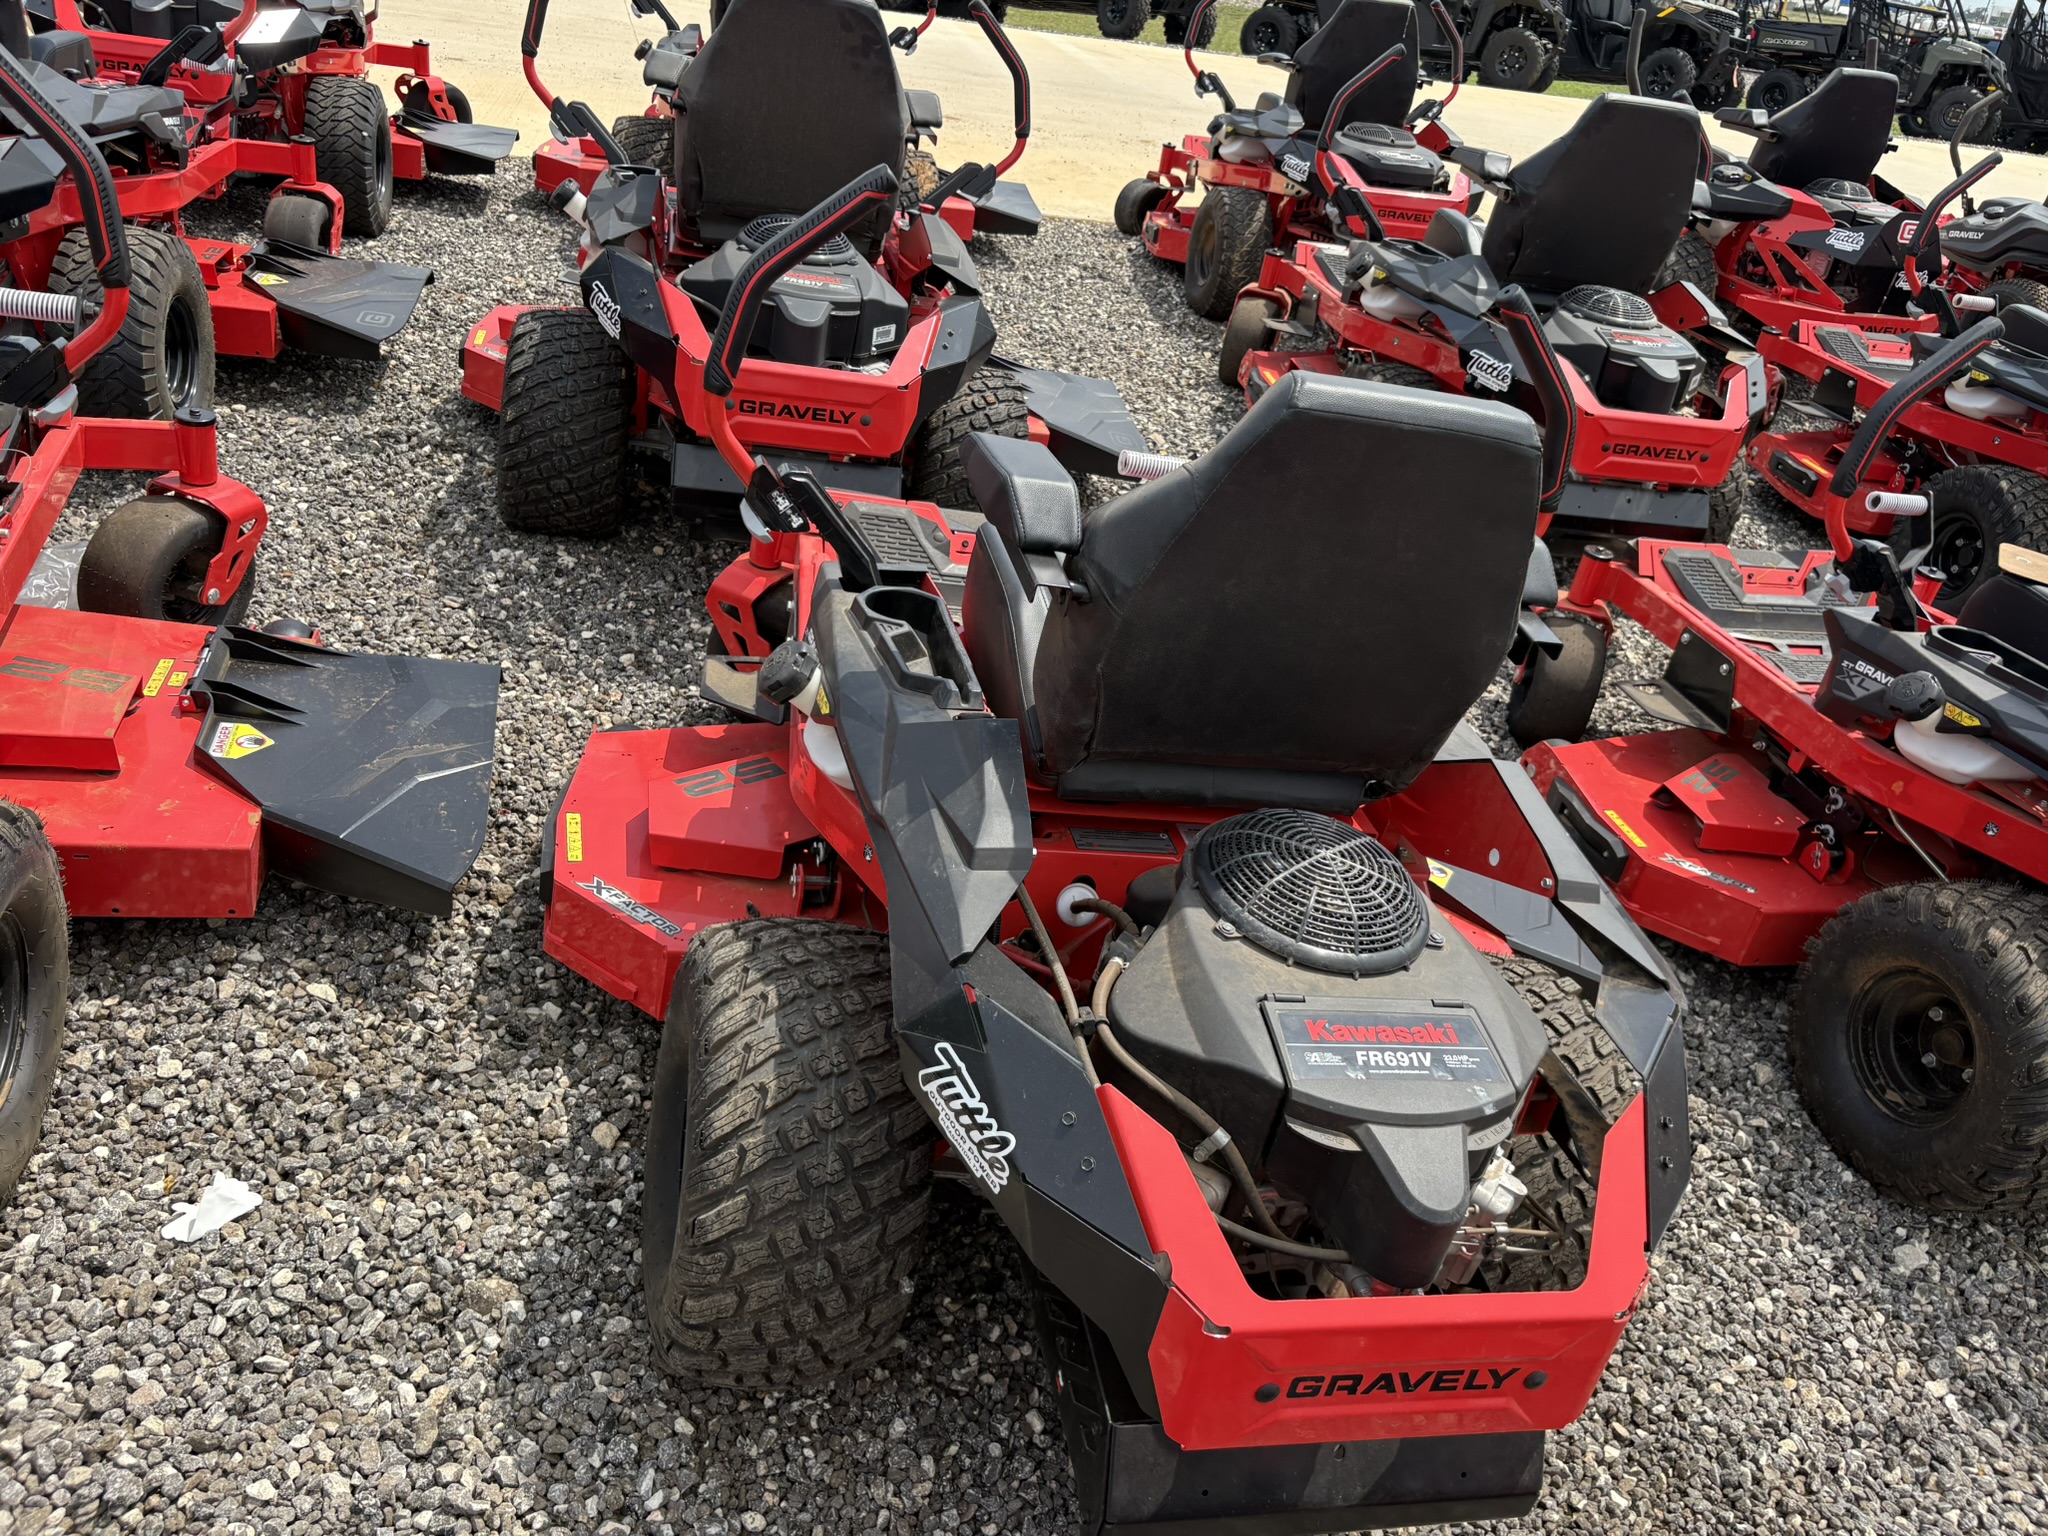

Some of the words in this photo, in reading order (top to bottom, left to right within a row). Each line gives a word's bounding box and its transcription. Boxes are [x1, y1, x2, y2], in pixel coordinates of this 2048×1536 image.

[103, 59, 187, 78] GRALY
[1826, 227, 1864, 246] Tuttle
[1948, 230, 1985, 239] GRAVELY
[591, 281, 620, 332] Tuttle
[1468, 350, 1511, 384] Tuttle
[739, 399, 857, 425] GRAVELY
[1612, 443, 1699, 461] GRAVELY
[1837, 667, 1871, 692] XL
[1841, 660, 1854, 669] ZT
[1854, 660, 1895, 687] GRAV
[212, 726, 232, 753] DANGER
[573, 875, 682, 937] X-FACTOR
[1304, 1019, 1460, 1045] Kawasaki
[1356, 1051, 1431, 1068] FR691V
[920, 1044, 1013, 1182] Tuttle
[929, 1090, 967, 1145] OUTDOOR
[968, 1145, 998, 1190] POWER
[1491, 1122, 1509, 1137] HERE
[971, 1162, 981, 1174] TX
[1286, 1367, 1522, 1399] GRAVELY
